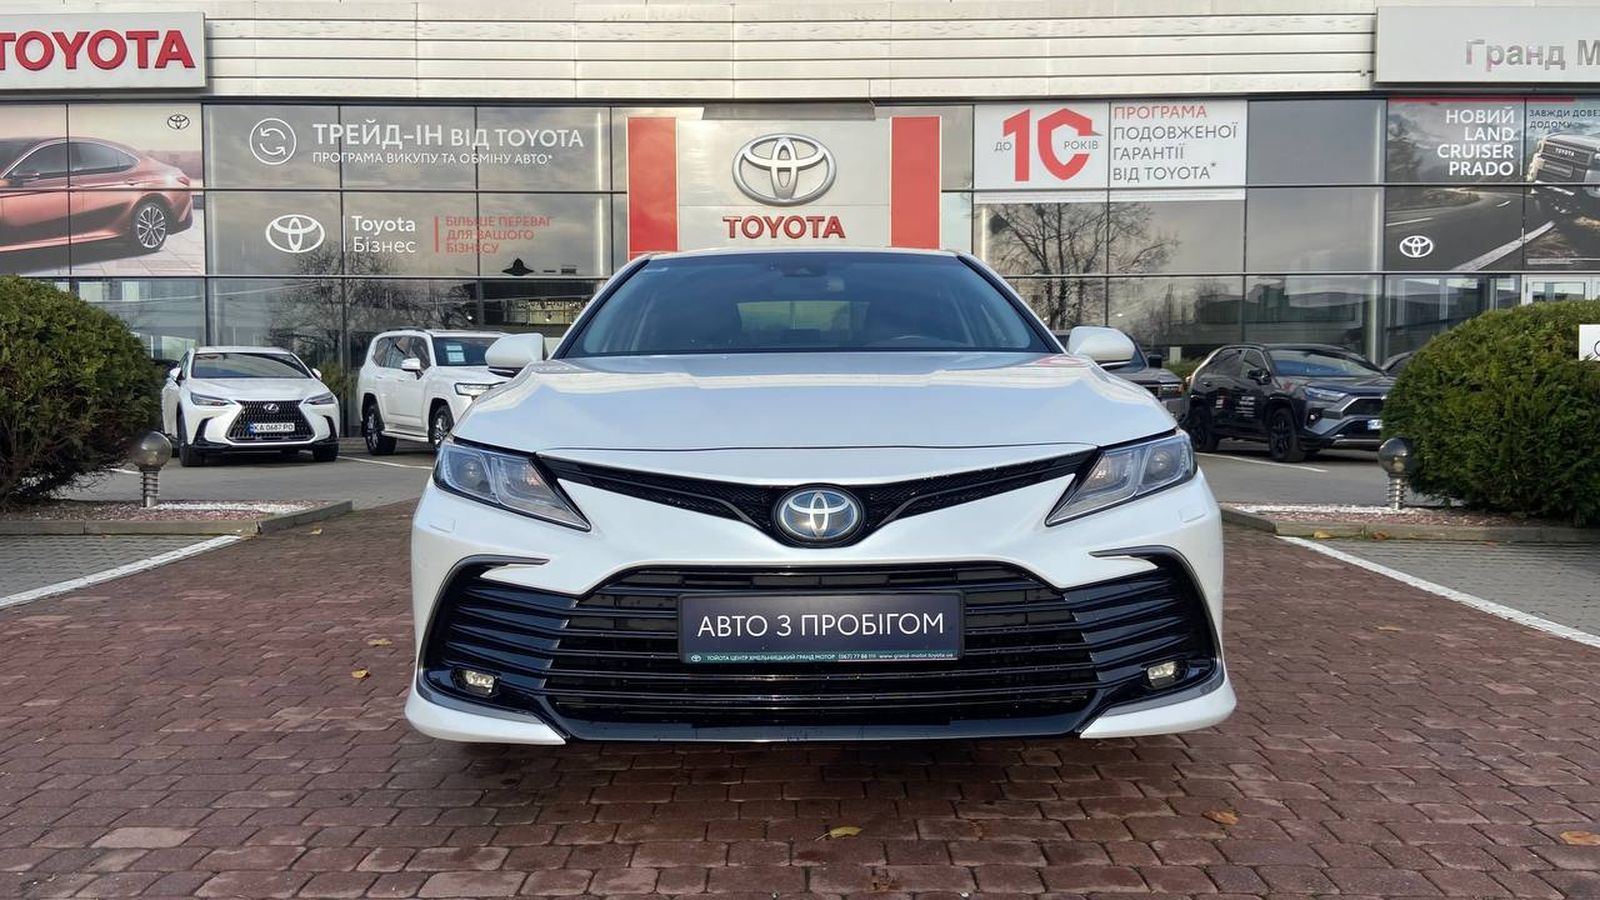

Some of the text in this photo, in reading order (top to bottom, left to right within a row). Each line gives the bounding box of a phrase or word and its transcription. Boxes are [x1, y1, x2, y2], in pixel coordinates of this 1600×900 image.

[1465, 39, 1566, 71] Гранд
[1113, 105, 1208, 120] ПРОГРАМА
[1445, 106, 1514, 124] НОВИЙ
[1529, 109, 1600, 118] ЗАВЖДИ ДОВЕ
[312, 119, 584, 150] ТРЕЙД-ІН ВІД TOYOTA
[1113, 121, 1239, 142] ПОДОВЖЕНОЇ
[1464, 127, 1514, 141] LAND
[993, 141, 1012, 152] ДО
[1063, 140, 1099, 151] РОКІВ
[1113, 143, 1185, 161] ГАРАНТІЇ
[1437, 144, 1514, 159] CRUISER
[312, 152, 382, 164] ПРОГРАМА
[386, 153, 437, 165] ВИКУПУ
[441, 153, 456, 164] ТА
[459, 153, 511, 165] ОБМІНУ
[1113, 168, 1140, 183] ВІД
[1449, 161, 1514, 176] PRADO
[351, 215, 416, 236] Toyota
[445, 216, 554, 227] БІЛЬШЕ ПЕРЕВАГ
[722, 215, 846, 239] TOYOTA
[446, 230, 535, 241] ДЛЯ ВАШОГО
[353, 236, 416, 253] Бізнес
[445, 242, 500, 254] БІЗНЕСУ
[697, 612, 944, 638] АВТО З ПРОБІГОМ
